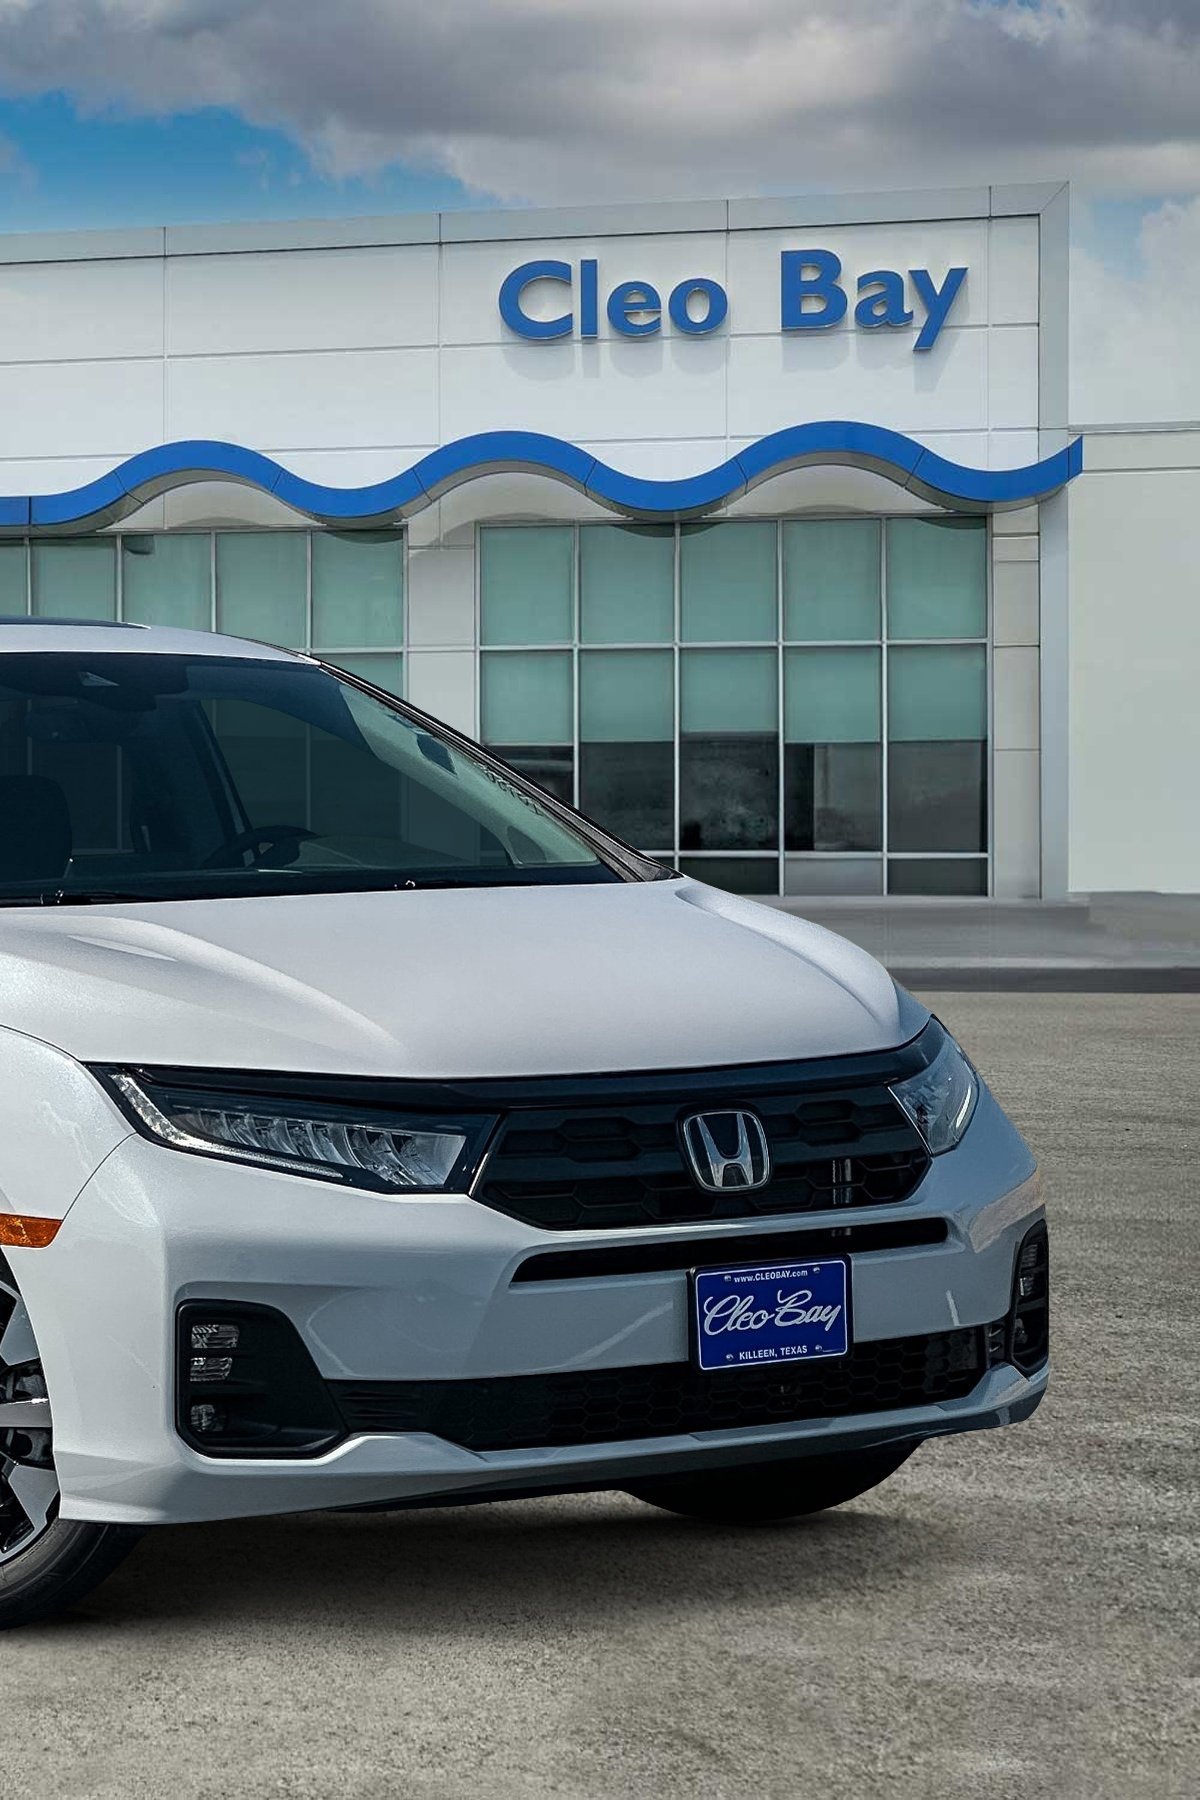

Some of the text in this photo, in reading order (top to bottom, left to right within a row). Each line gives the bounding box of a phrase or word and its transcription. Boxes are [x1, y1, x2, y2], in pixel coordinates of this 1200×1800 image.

[499, 248, 969, 351] Cleo Bay
[734, 1269, 808, 1283] www.CLEOBAY.com
[703, 1289, 841, 1336] Cleo Bay
[739, 1348, 778, 1361] KILLEEN,
[780, 1345, 808, 1356] TEXAS
